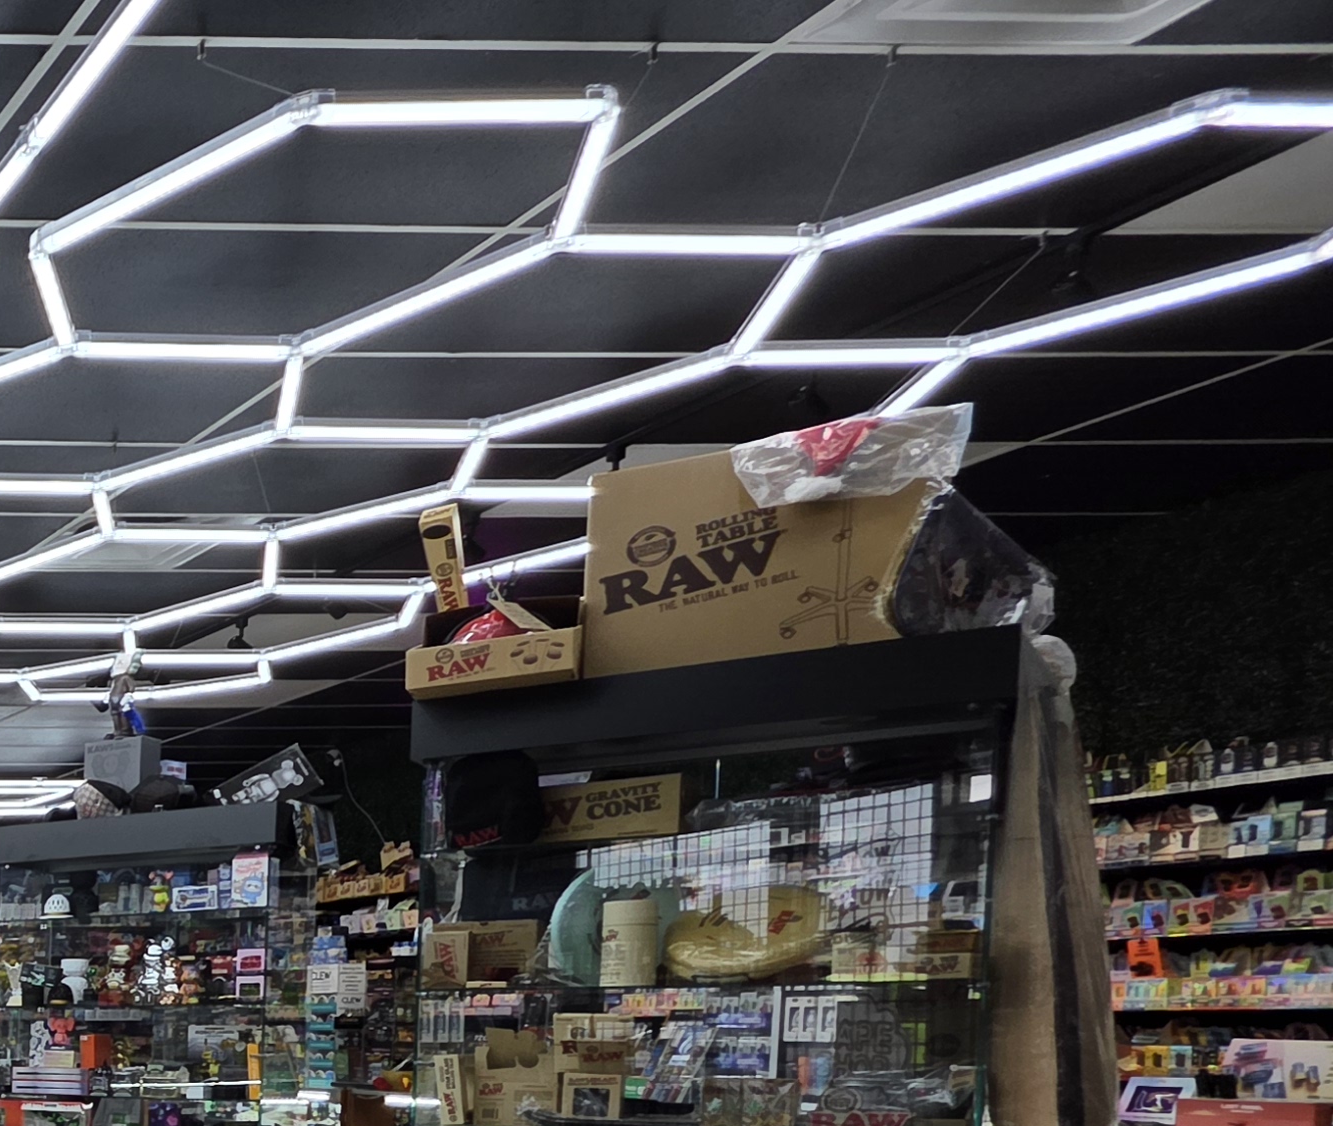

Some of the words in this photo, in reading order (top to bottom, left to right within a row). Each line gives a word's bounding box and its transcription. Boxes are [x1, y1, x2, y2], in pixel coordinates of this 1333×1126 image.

[695, 506, 777, 534] ROLLING
[696, 519, 779, 548] TABLE
[599, 533, 787, 615] RAW
[436, 574, 460, 612] RAW
[659, 600, 678, 613] THE
[682, 590, 728, 609] NATURAL
[731, 583, 751, 595] WAY
[753, 578, 768, 589] TO
[771, 570, 800, 585] ROLL
[426, 651, 491, 682] RAW
[585, 781, 663, 804] GRAVITY
[586, 794, 663, 820] CONE
[454, 824, 500, 847] RAW
